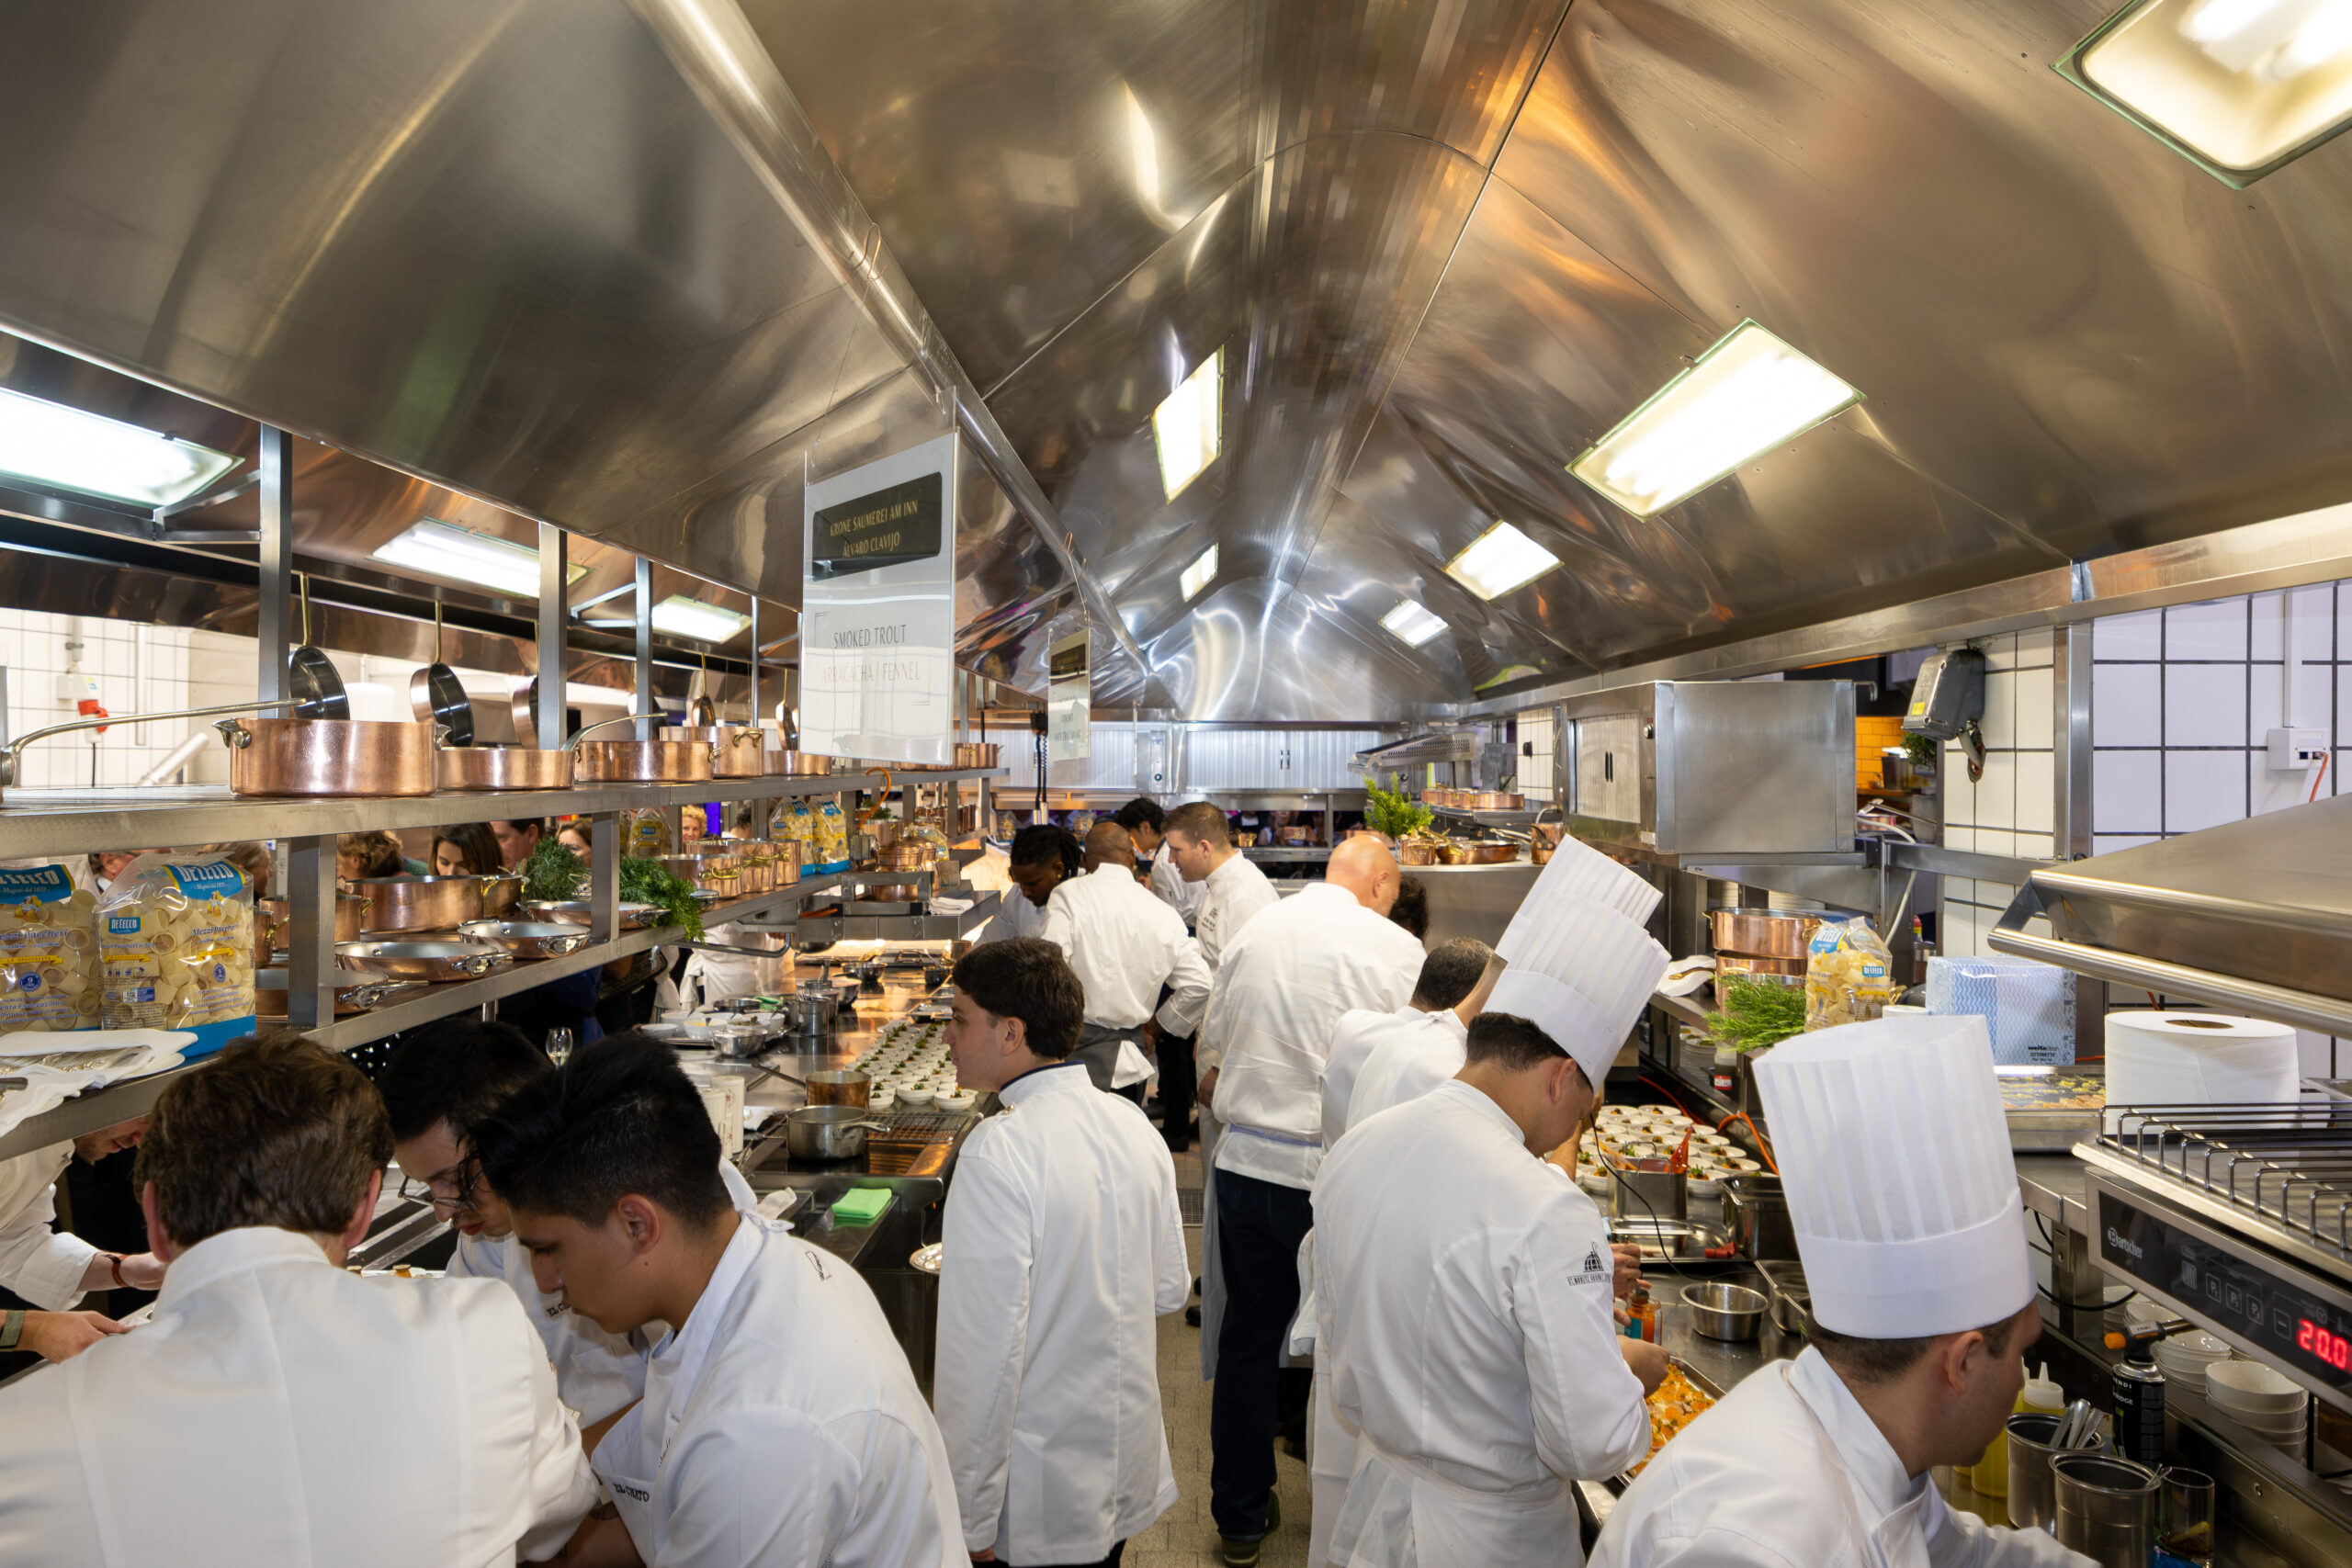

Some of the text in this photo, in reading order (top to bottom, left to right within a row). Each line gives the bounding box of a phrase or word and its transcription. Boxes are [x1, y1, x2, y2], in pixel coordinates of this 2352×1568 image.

[831, 519, 851, 537] KRONE
[888, 504, 901, 520] AM
[903, 500, 918, 516] INN
[870, 532, 900, 552] CLAVIJO
[833, 625, 907, 649] SMOKED TROUT
[882, 661, 922, 682] FENNEL
[0, 929, 68, 940] ezzi Paccheri
[2108, 1227, 2143, 1259] Bartscher
